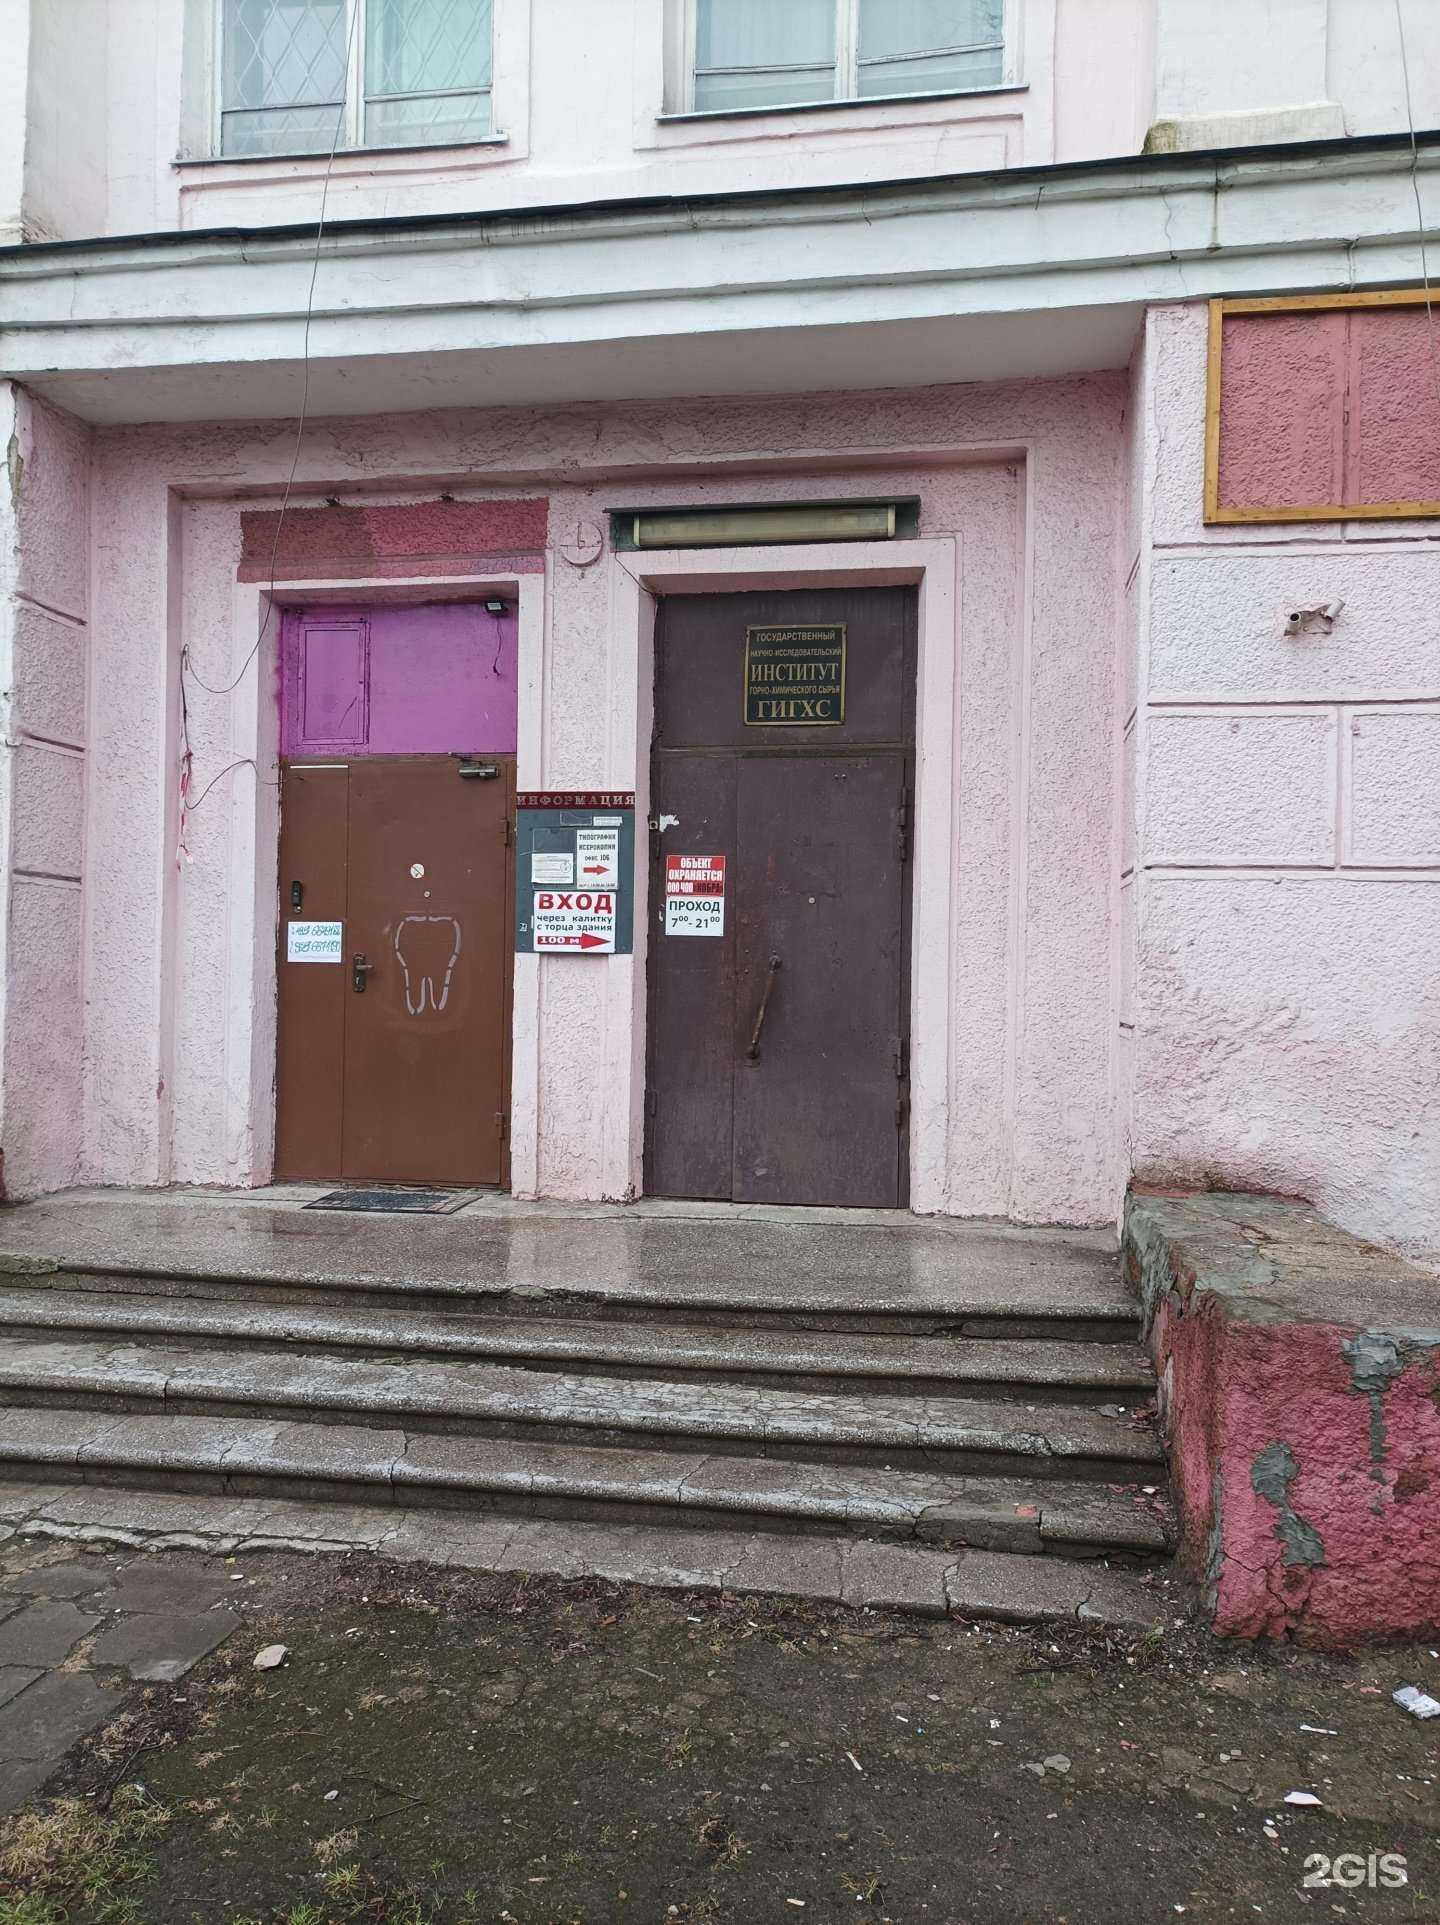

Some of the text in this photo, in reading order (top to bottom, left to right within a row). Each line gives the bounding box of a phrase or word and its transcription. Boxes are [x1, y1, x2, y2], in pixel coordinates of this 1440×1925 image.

[756, 630, 836, 642] ГОСУДАРСТВЕННЫЙ
[750, 663, 839, 682] ИНСТИТУТ
[757, 699, 831, 718] ГИГХС
[517, 795, 635, 806] ИНФОРМАЦИЯ
[680, 857, 712, 869] ОБЪЕКТ
[668, 869, 723, 881] ОХРАНЯЕТСЯ
[538, 893, 613, 914] ВХОД
[669, 901, 721, 913] ПРОХОД
[536, 915, 613, 924] через калитку
[545, 924, 574, 932] торца
[576, 924, 612, 932] здания
